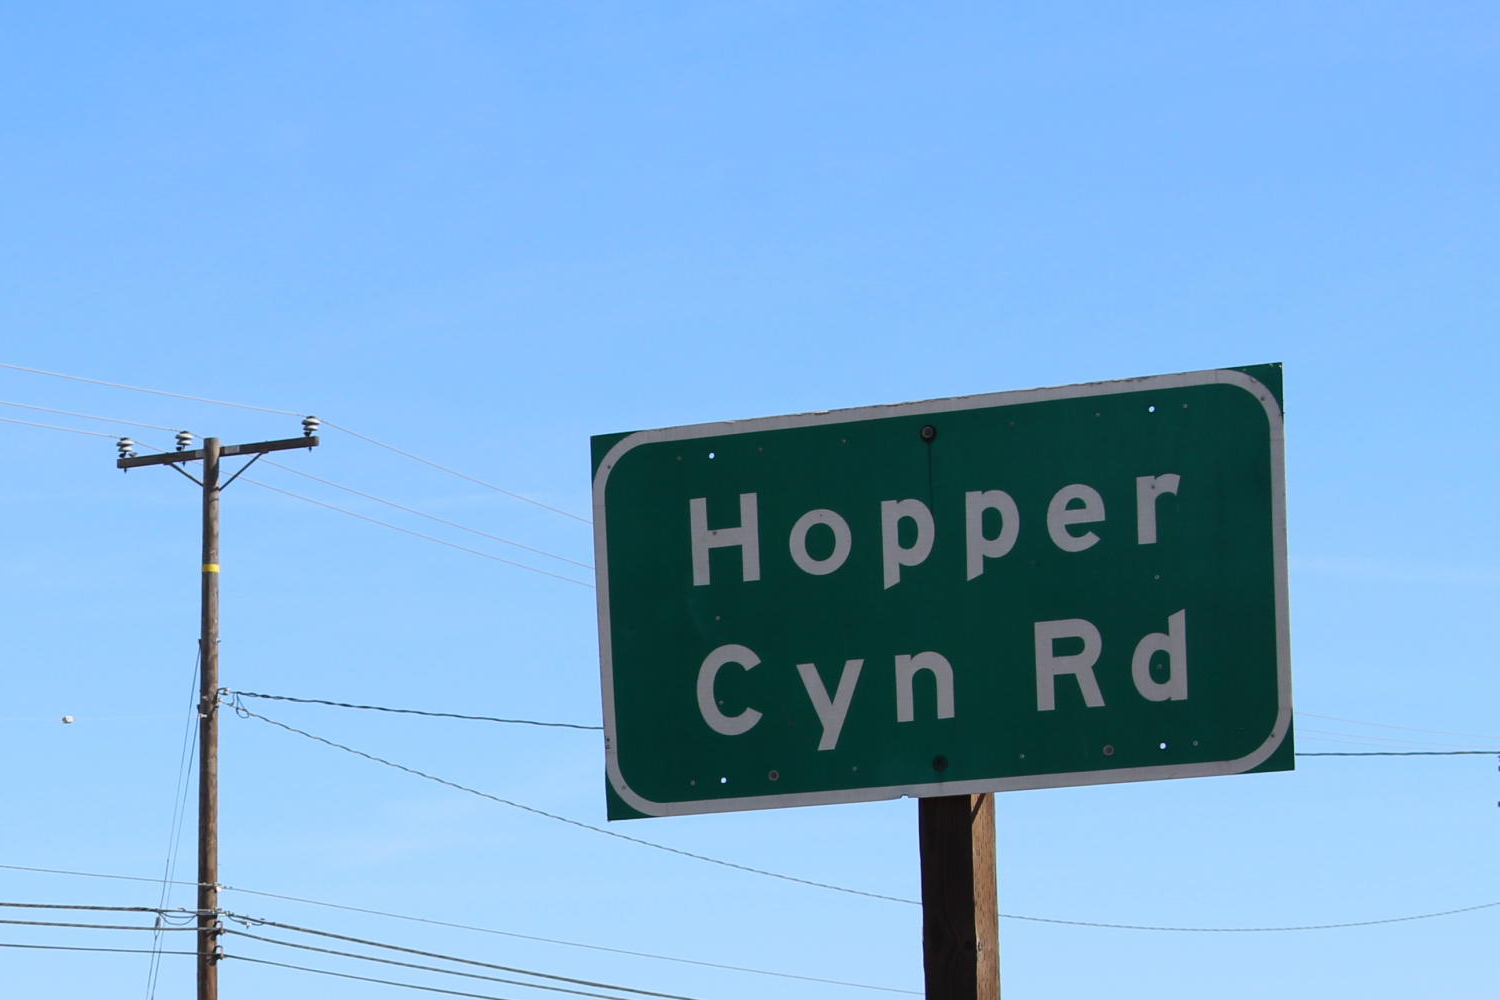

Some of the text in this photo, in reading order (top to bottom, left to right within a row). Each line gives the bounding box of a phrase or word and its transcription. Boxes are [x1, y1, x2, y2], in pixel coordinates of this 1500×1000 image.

[689, 472, 1181, 590] Hopper
[696, 607, 1189, 751] Cyn Rd
